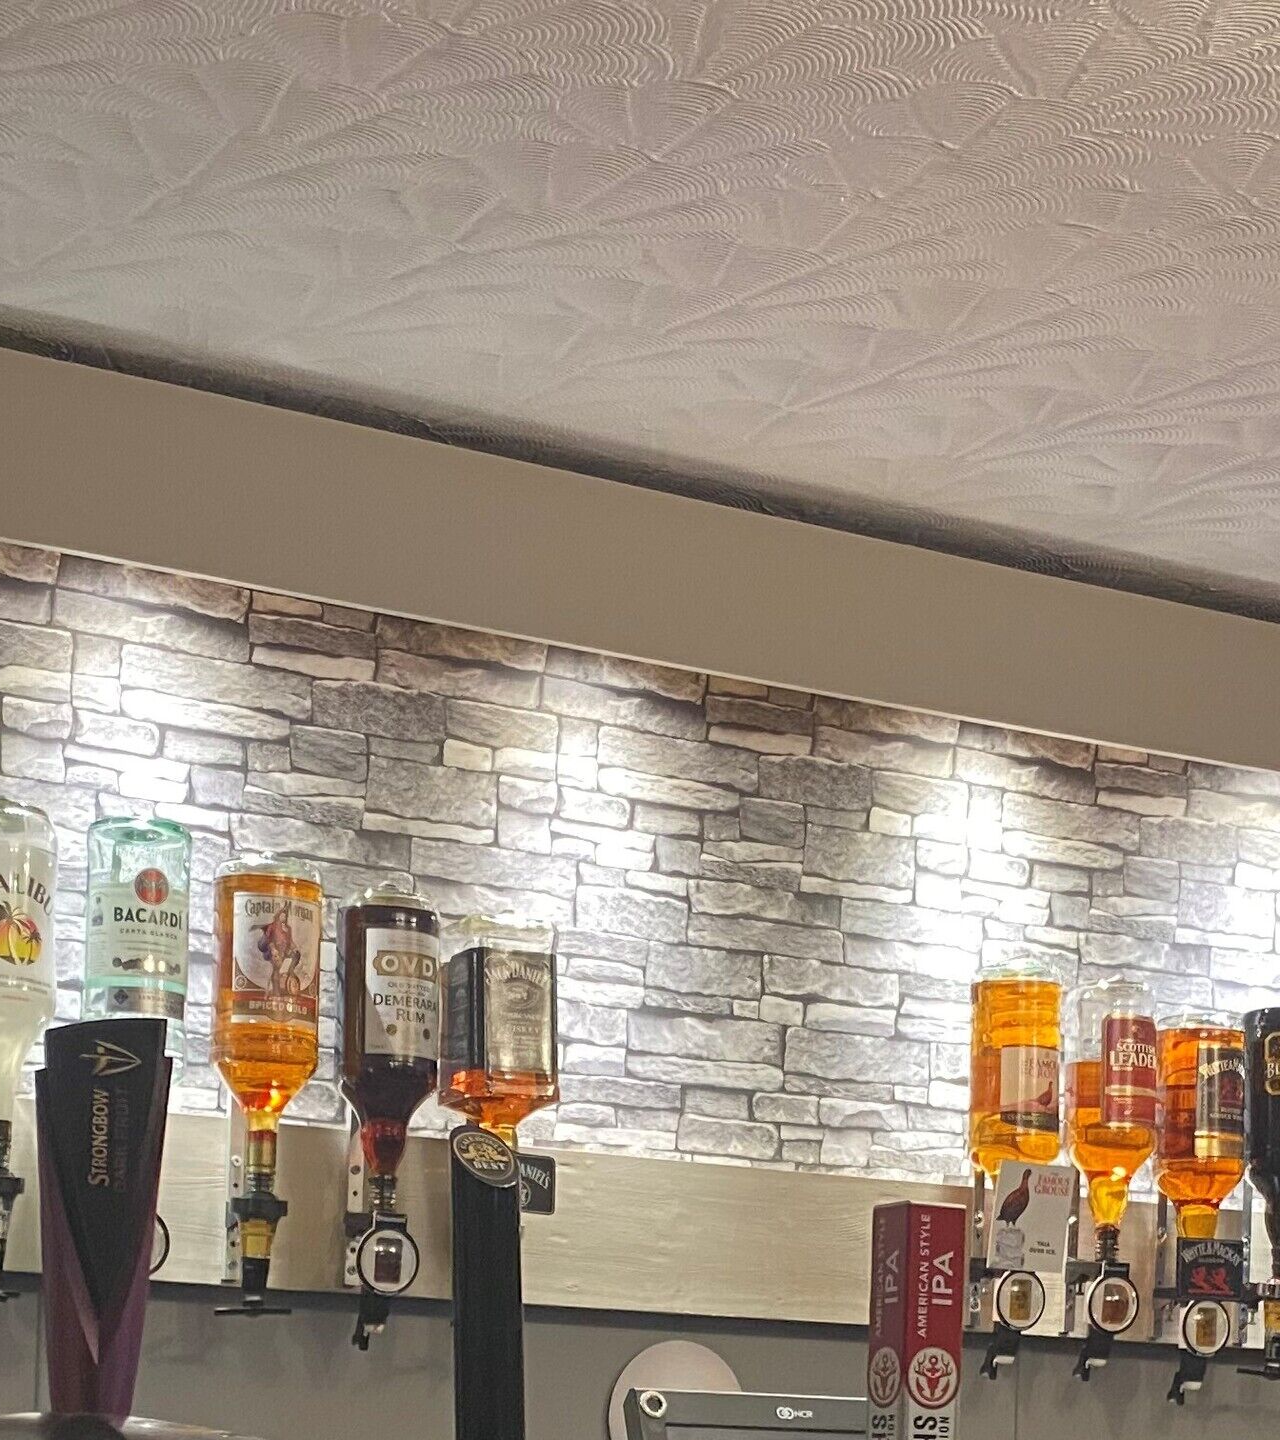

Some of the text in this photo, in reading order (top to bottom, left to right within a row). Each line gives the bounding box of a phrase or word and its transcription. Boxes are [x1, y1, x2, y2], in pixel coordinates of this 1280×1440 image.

[381, 955, 433, 978] OVD
[396, 1009, 426, 1024] RUM
[87, 1088, 111, 1188] STRONGBOW
[519, 1161, 552, 1191] ANIEL'S
[884, 1249, 900, 1305] IPA
[917, 1214, 932, 1338] AMERICAN STYLE
[932, 1250, 954, 1306] IPA
